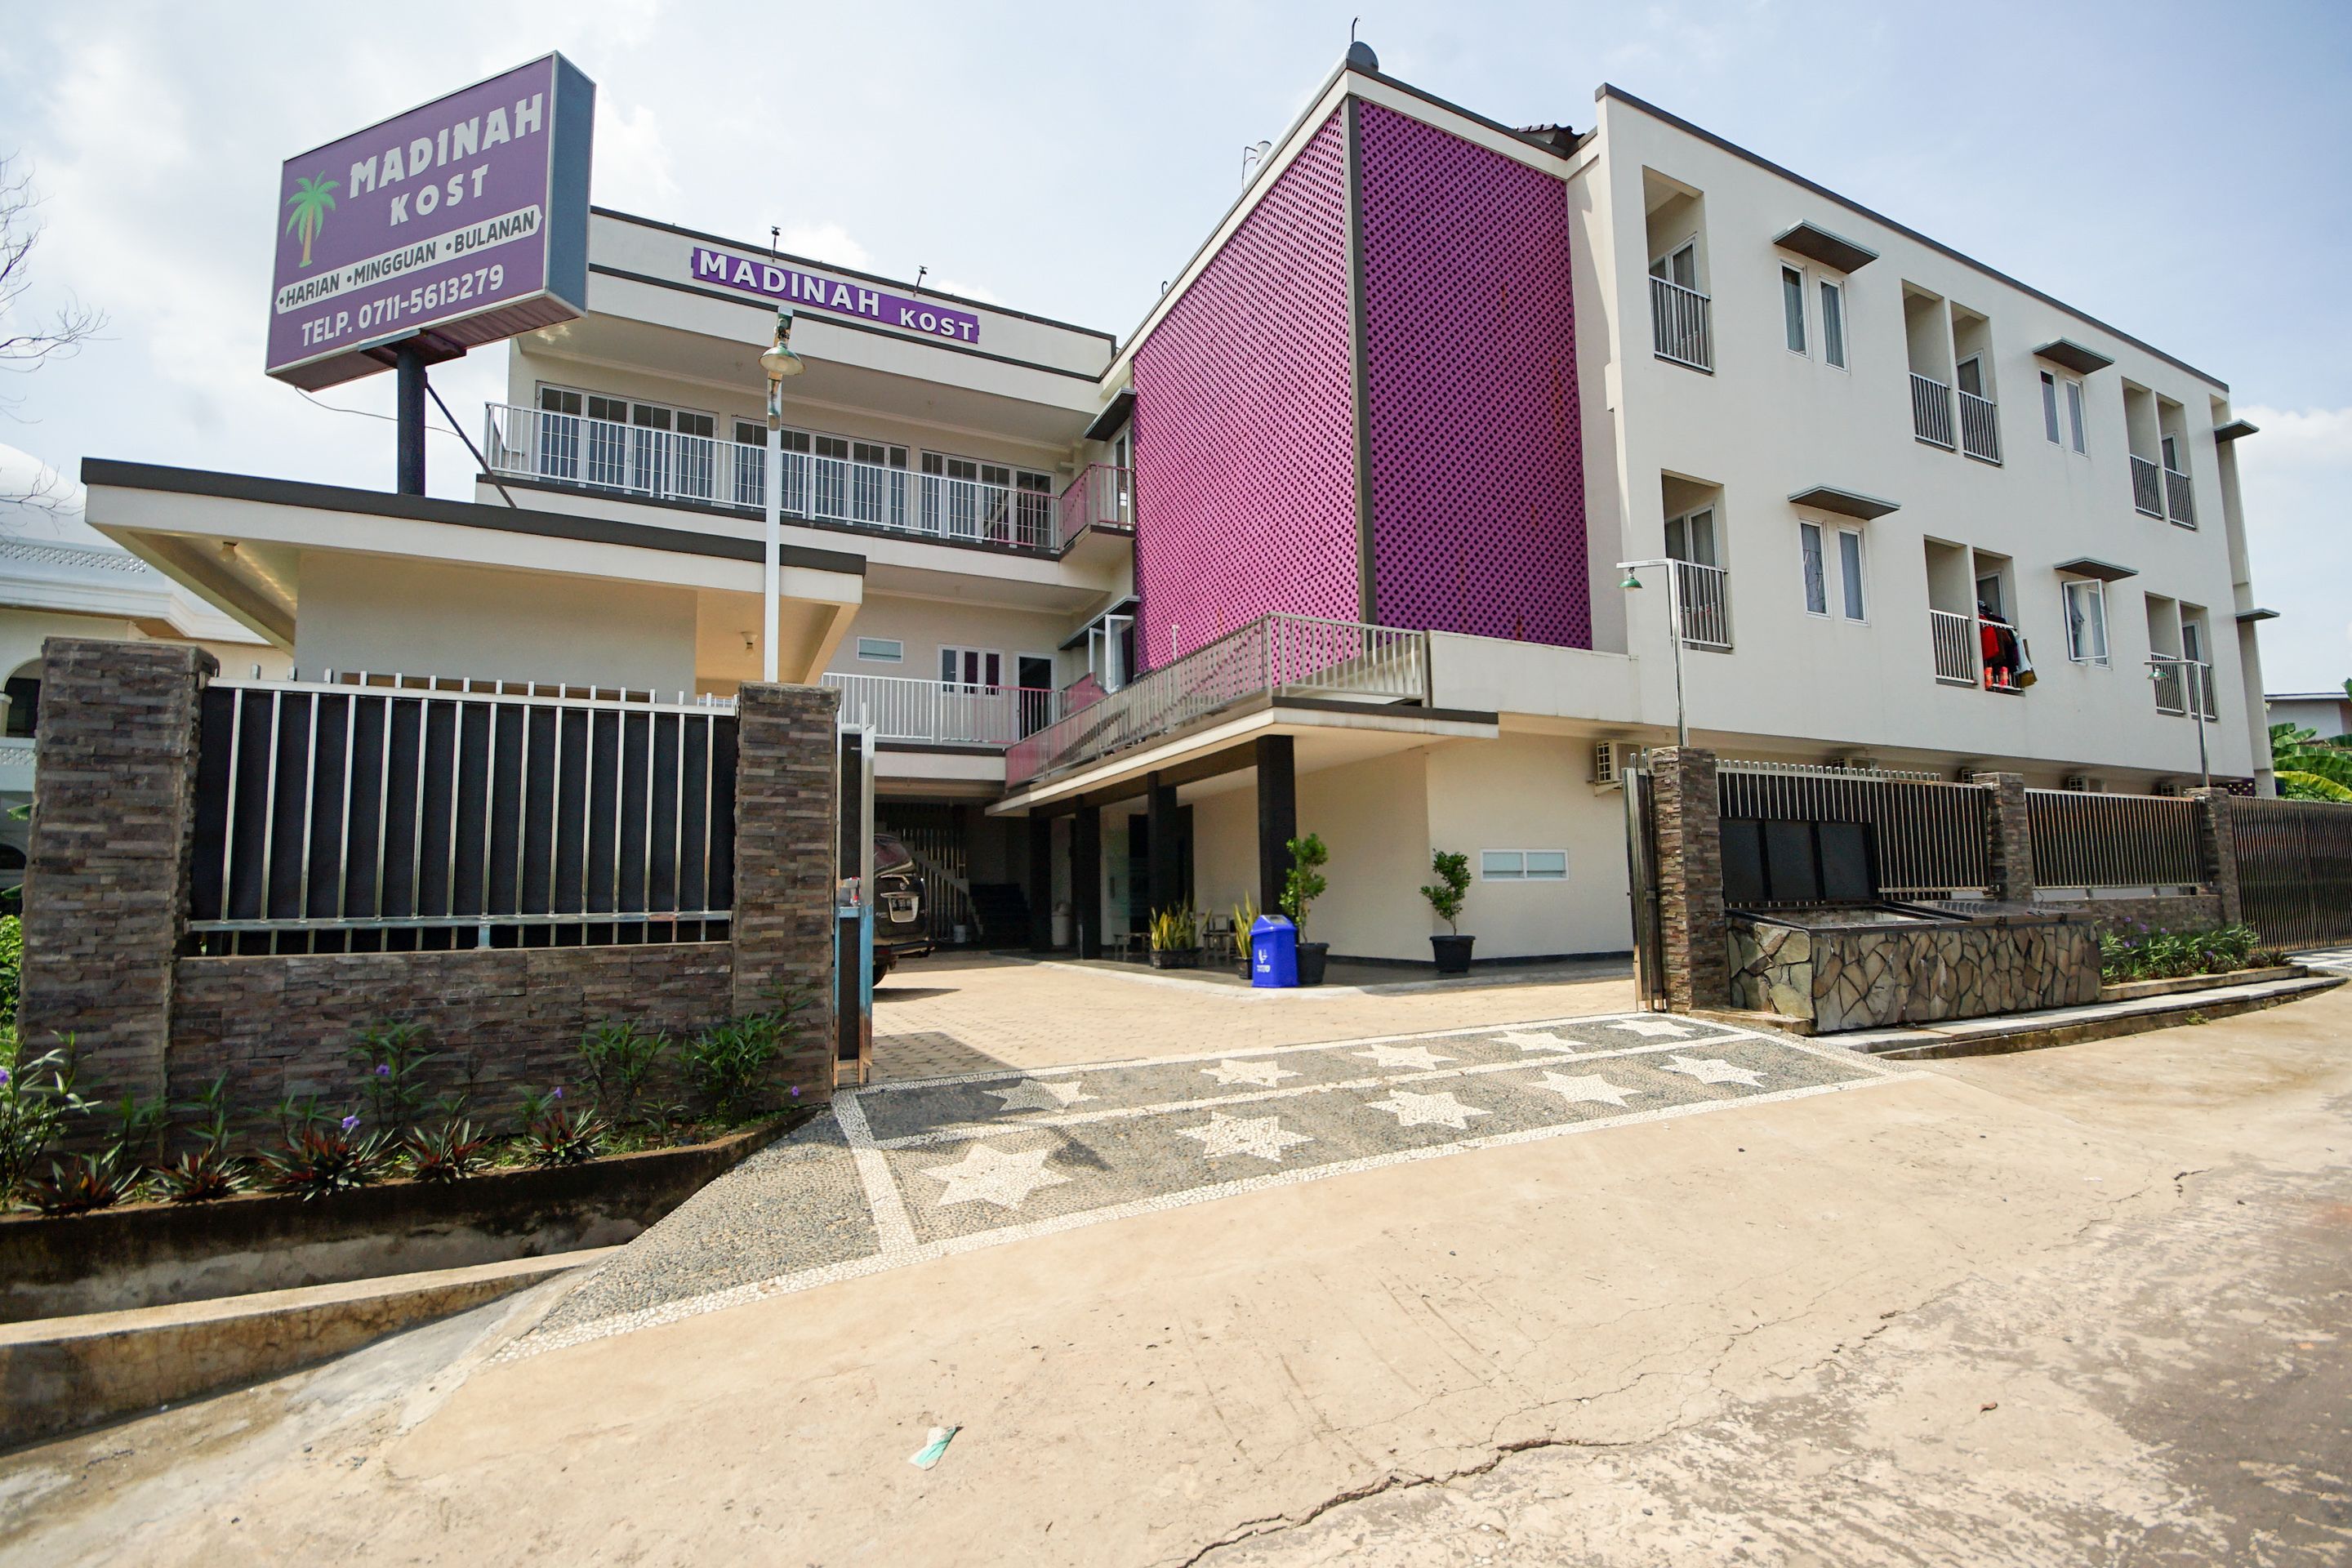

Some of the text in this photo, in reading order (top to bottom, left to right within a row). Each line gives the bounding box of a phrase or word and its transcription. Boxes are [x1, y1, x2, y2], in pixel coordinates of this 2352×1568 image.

[350, 93, 542, 198] MADINAH
[390, 164, 489, 226] KOST
[285, 210, 535, 308] HARIAN MINGGUAN BULANAN
[699, 250, 973, 341] MADINAH KOST
[301, 264, 504, 346] TELP. 0711-5613279
